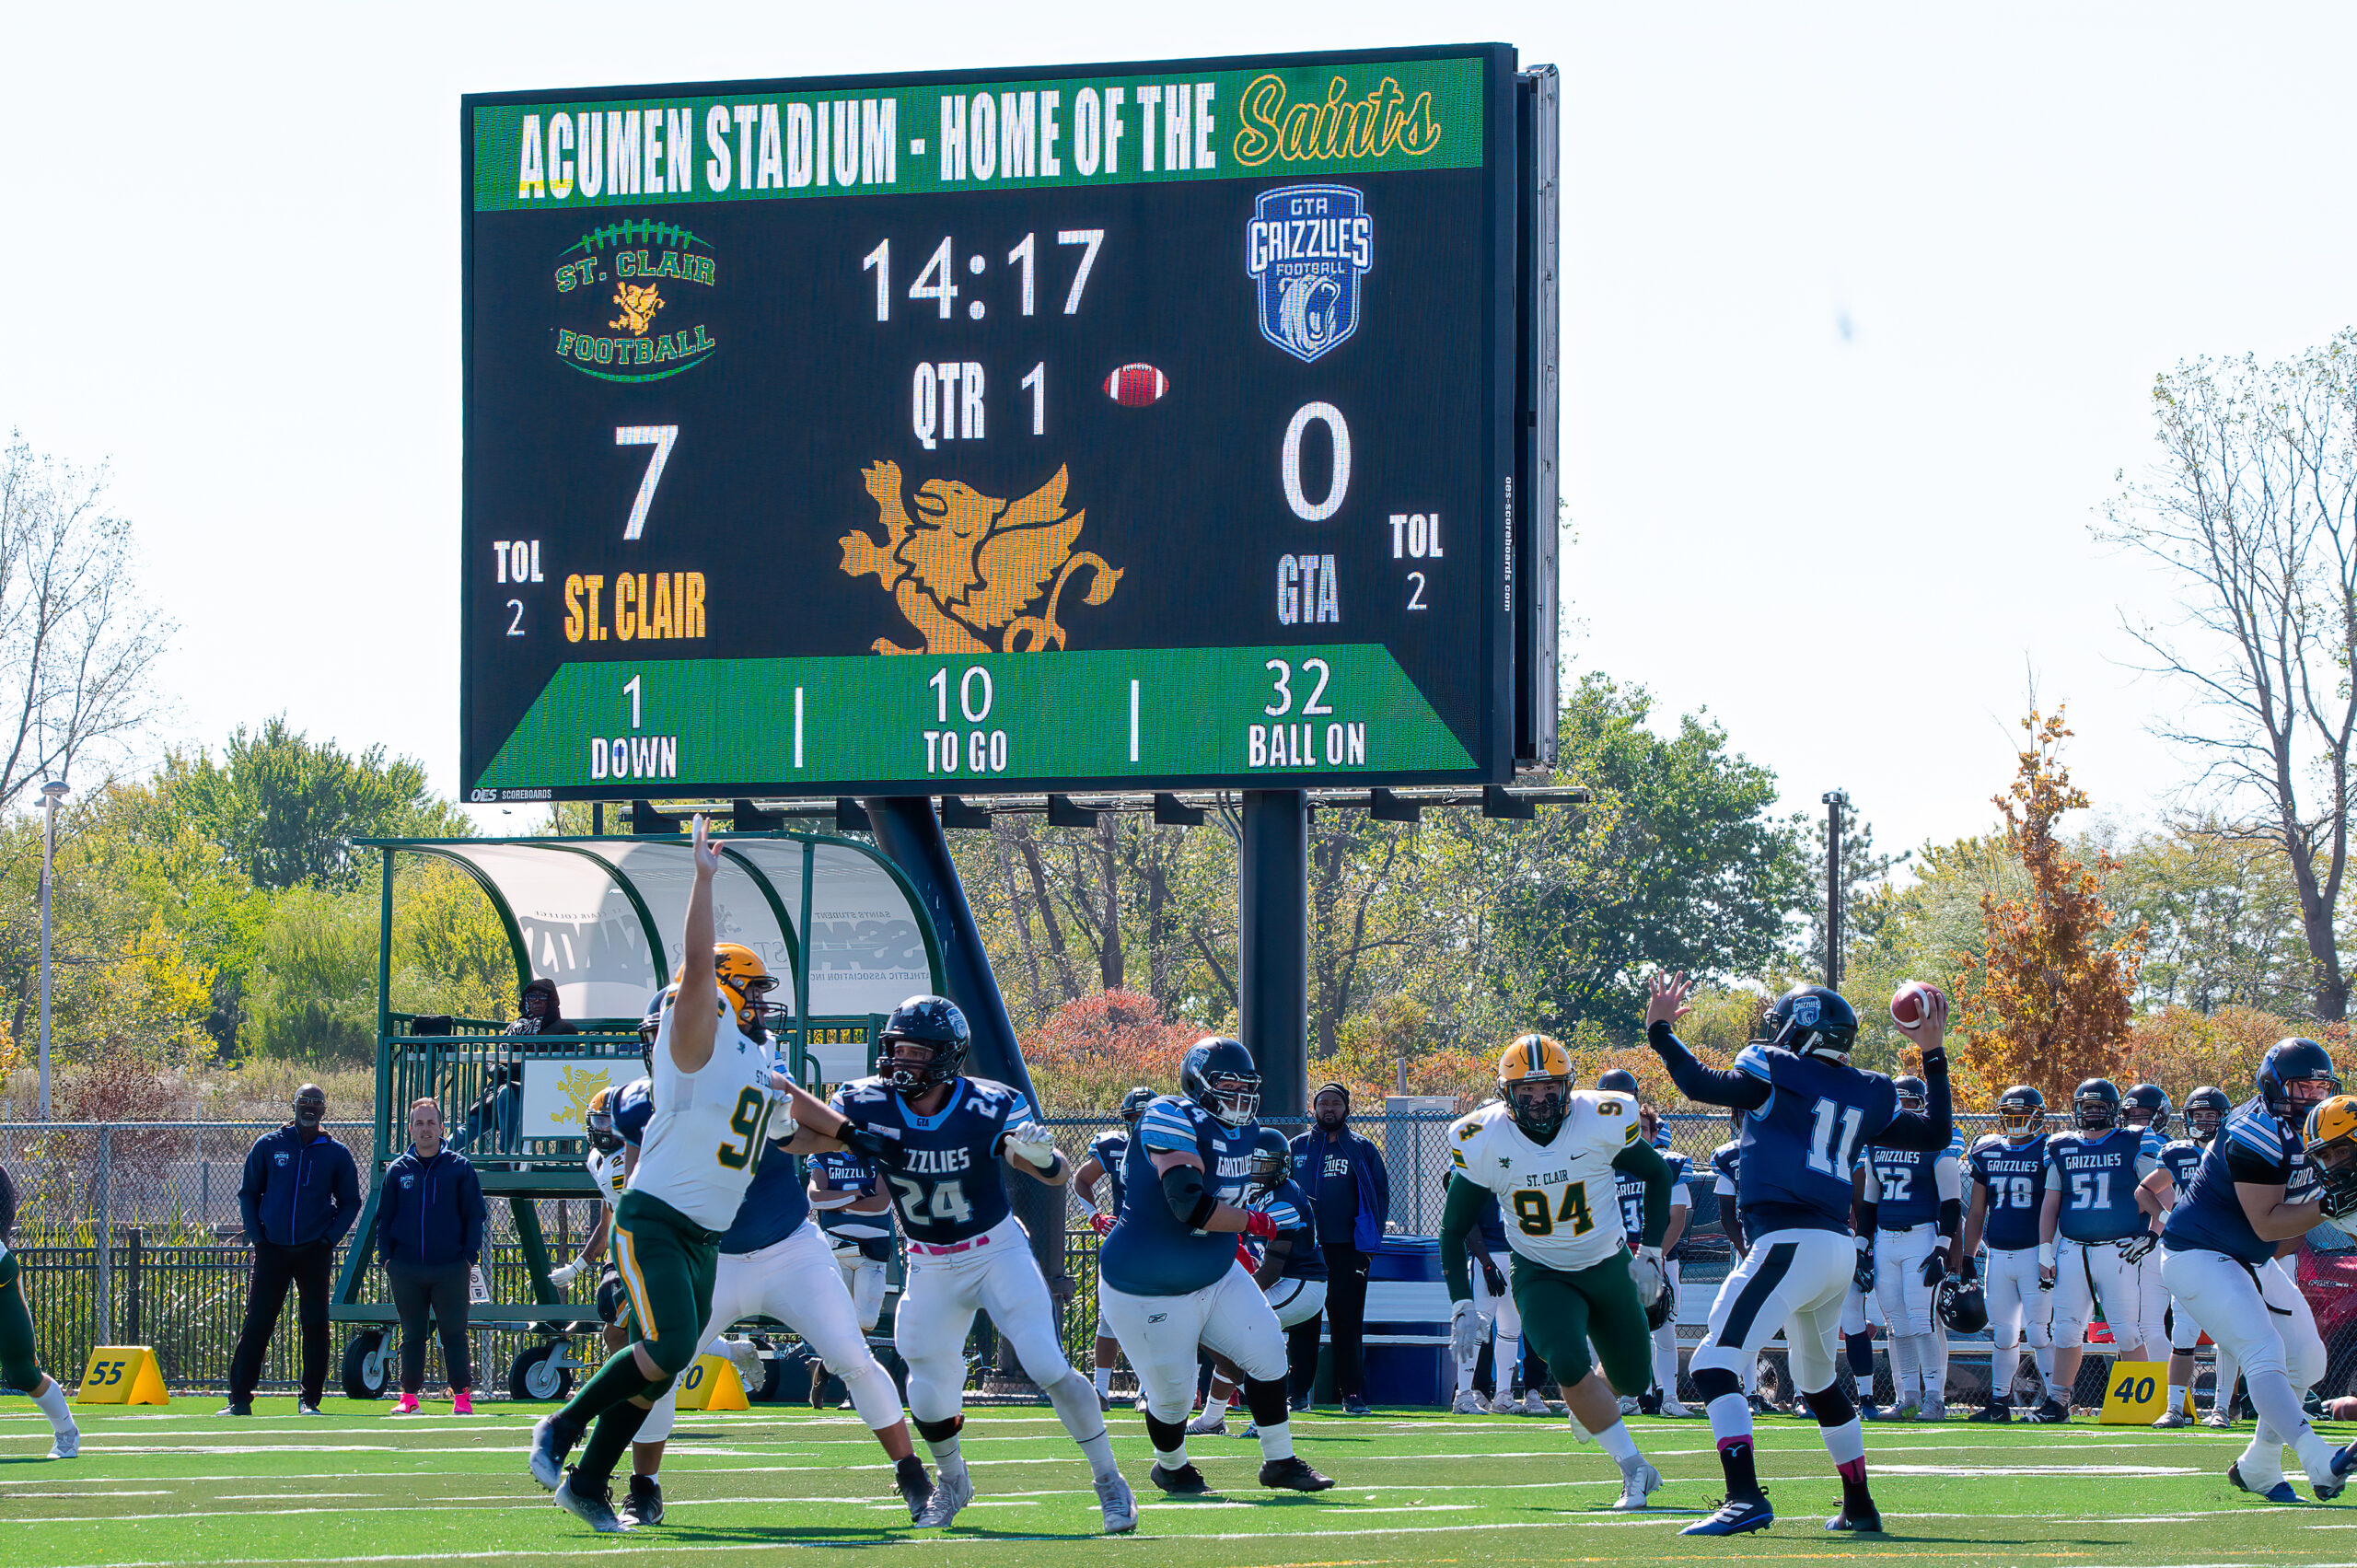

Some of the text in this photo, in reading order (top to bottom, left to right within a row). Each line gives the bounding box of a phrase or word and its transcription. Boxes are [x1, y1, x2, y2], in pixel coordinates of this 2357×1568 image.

[517, 107, 692, 200] ACUMEN
[705, 98, 897, 193] STADIUM
[940, 89, 1061, 182] HOME
[1074, 86, 1125, 177] OF
[1136, 82, 1217, 173] THE
[1234, 74, 1442, 167] Saints
[1291, 197, 1328, 217] GTA
[1250, 217, 1372, 273] GRIZZLIES
[554, 250, 715, 293] ST. CLAIR
[862, 228, 1106, 323] 14:17
[1276, 260, 1347, 278] FOOTBALL
[555, 324, 716, 366] FOOTBALL
[911, 361, 1045, 450] QTR 1
[615, 424, 679, 541] 7
[1282, 401, 1352, 523] 0
[1389, 513, 1444, 559] TOL
[493, 540, 544, 584] TOL
[564, 572, 706, 643] ST. CLAIR
[1277, 553, 1340, 626] GTA
[1407, 571, 1427, 610] 2
[505, 599, 525, 637] 2
[623, 674, 642, 729] 1
[929, 666, 993, 723] 10
[1264, 657, 1333, 717] 32
[591, 735, 678, 780] DOWN
[923, 728, 1007, 773] TO GO
[1248, 722, 1365, 768] BALL ON
[502, 789, 552, 800] SCOREBOARDS
[903, 1147, 970, 1174] ZZLIES
[1806, 1096, 1864, 1185] 11
[1874, 1150, 1922, 1165] GRIZZLIES
[2064, 1153, 2122, 1170] GRIZZLIES
[1527, 1169, 1569, 1187] ST. CLAIR
[1875, 1166, 1913, 1202] 52
[1987, 1160, 2039, 1173] GRIZZLIES
[887, 1173, 974, 1227] 24
[1512, 1180, 1596, 1237] 94
[1989, 1176, 2034, 1210] 78
[2070, 1171, 2113, 1211] 51
[87, 1360, 126, 1386] 55
[2113, 1376, 2156, 1404] 40
